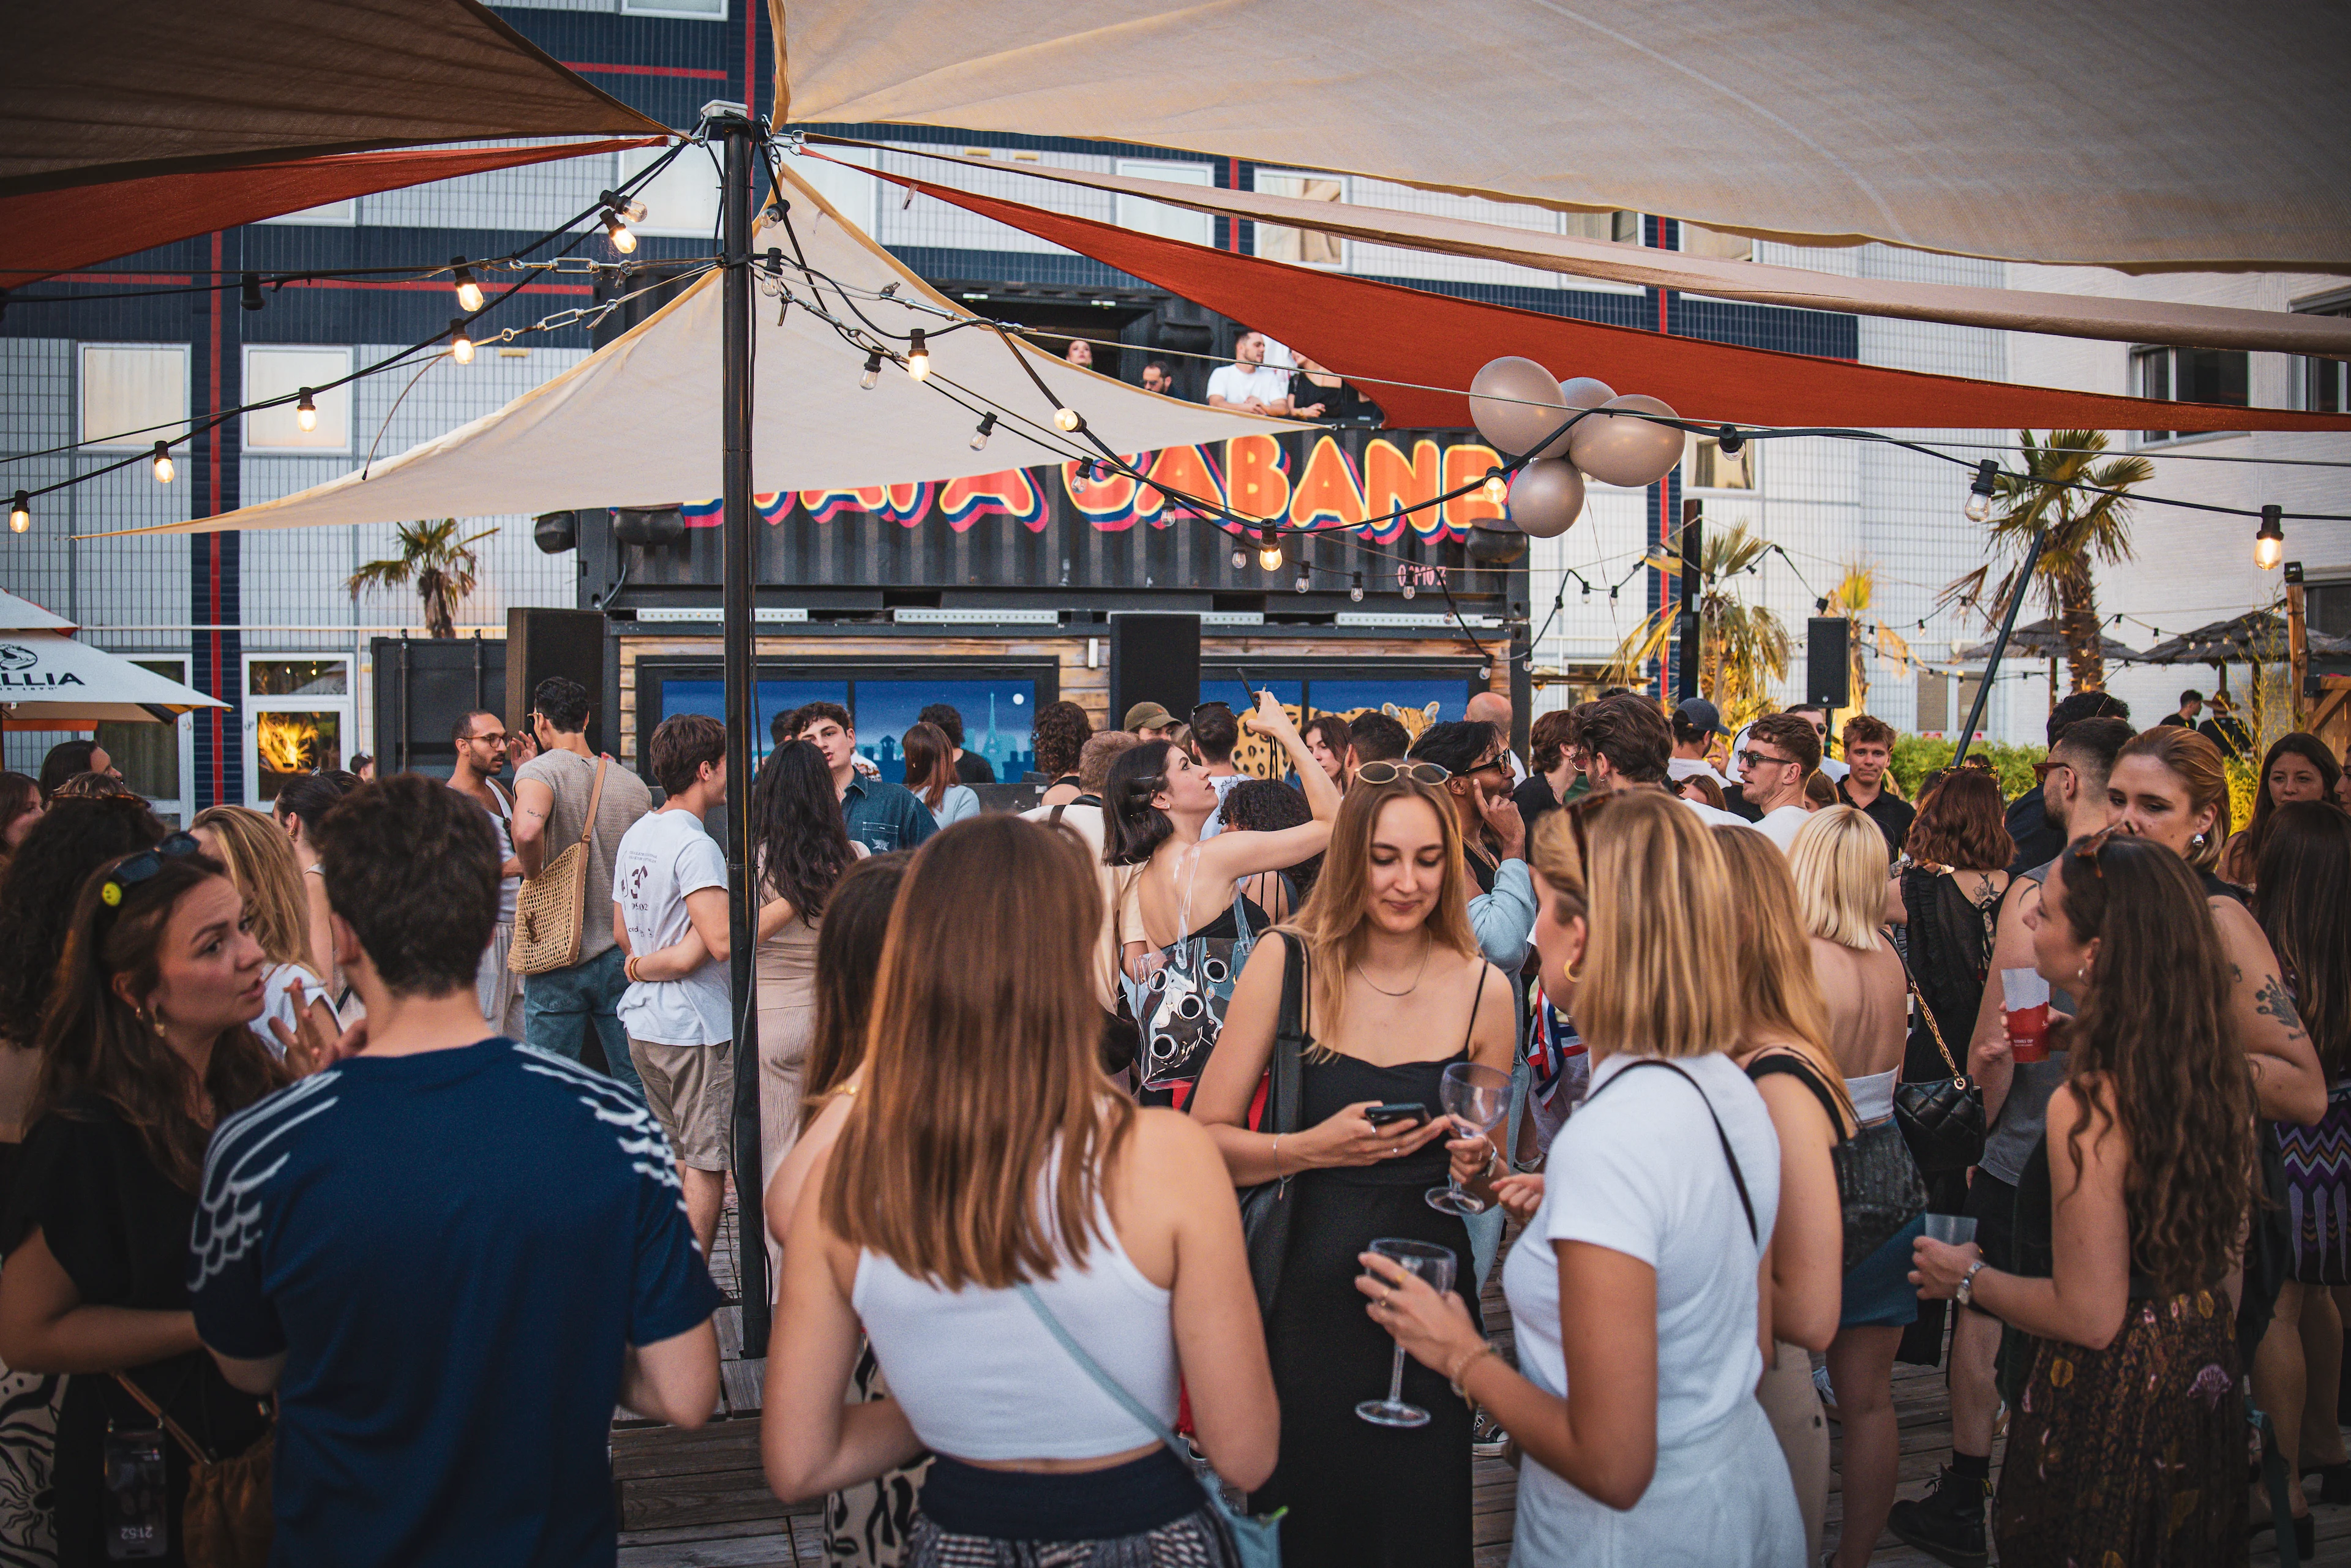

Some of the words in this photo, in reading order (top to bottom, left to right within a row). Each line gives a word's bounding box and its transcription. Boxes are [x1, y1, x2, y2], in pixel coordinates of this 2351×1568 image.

[1061, 433, 1512, 539] CABANE
[1398, 564, 1447, 587] OMOZ
[0, 673, 85, 686] LLIA
